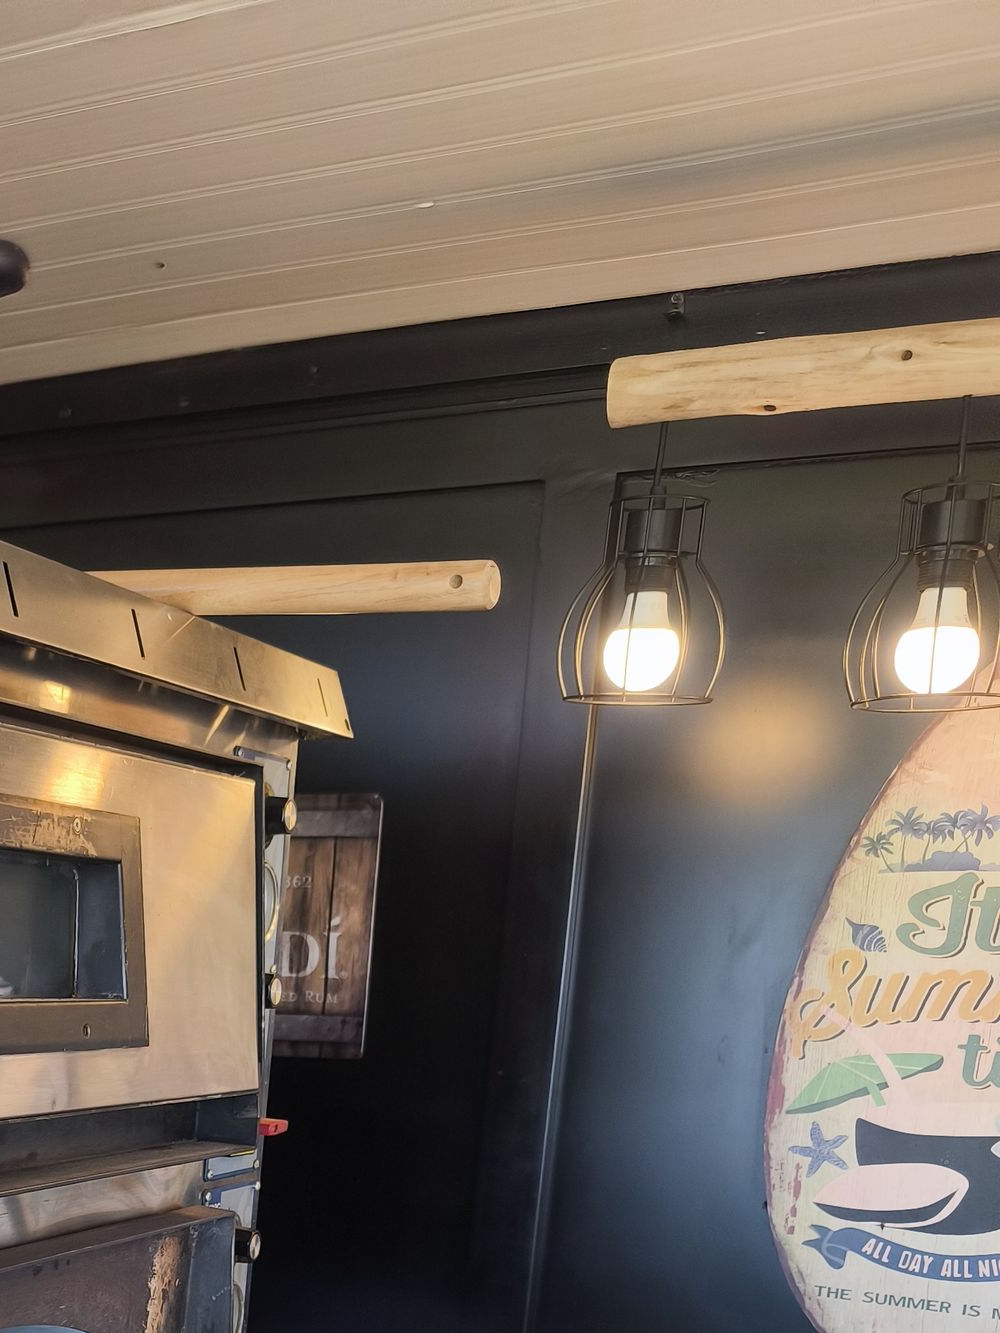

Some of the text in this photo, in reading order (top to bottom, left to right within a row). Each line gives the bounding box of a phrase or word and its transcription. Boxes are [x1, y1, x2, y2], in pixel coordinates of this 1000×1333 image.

[788, 949, 1000, 1060] Sum
[861, 1238, 1000, 1279] ALL DAY ALL NI
[813, 1284, 853, 1301] THE
[861, 1291, 951, 1314] SUMMER
[961, 1303, 982, 1318] IS
